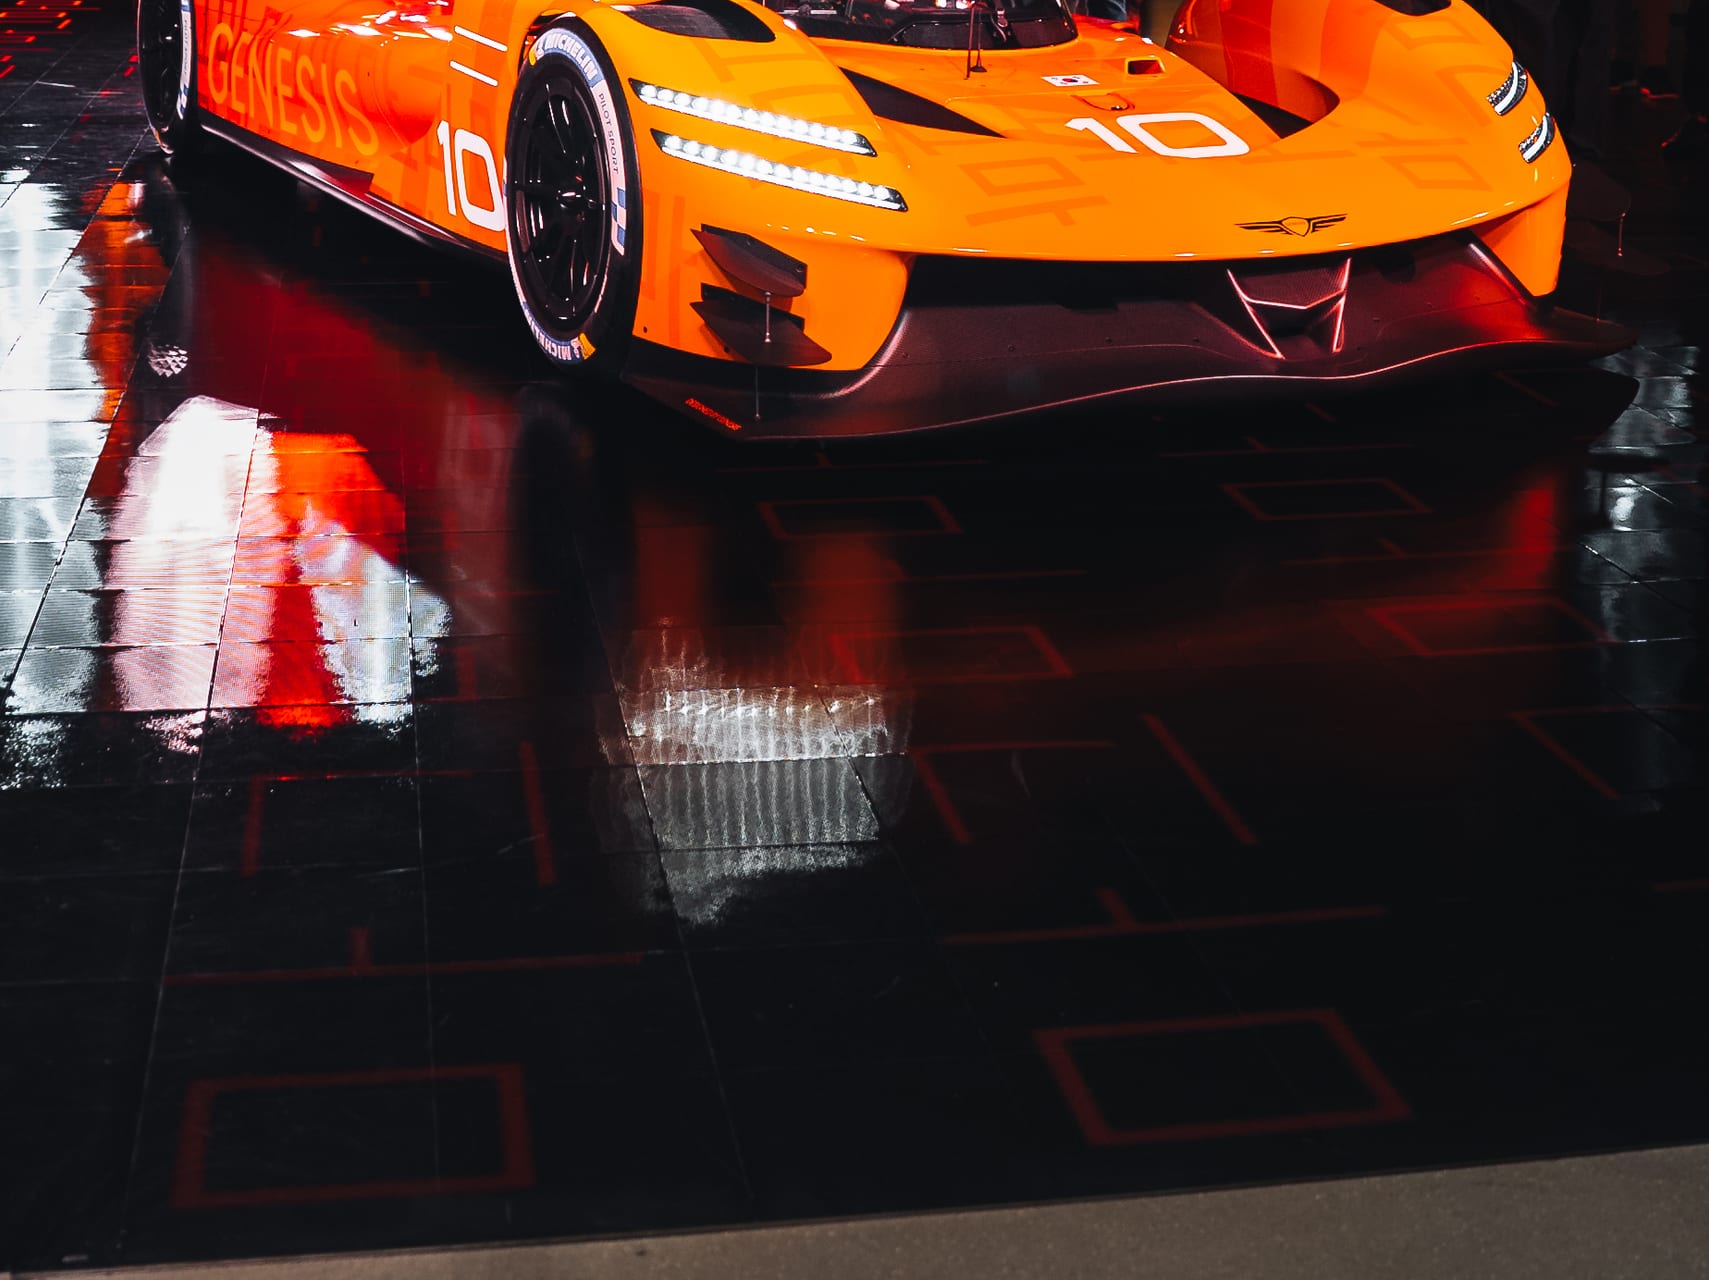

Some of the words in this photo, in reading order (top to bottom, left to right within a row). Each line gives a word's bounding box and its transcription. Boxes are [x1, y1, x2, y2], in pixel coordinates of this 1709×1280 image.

[207, 22, 379, 156] GENESIS
[545, 33, 598, 81] MICHELIN
[599, 93, 612, 126] PILOT
[608, 130, 619, 174] SPORT
[1064, 112, 1250, 158] 10
[436, 120, 506, 232] 10
